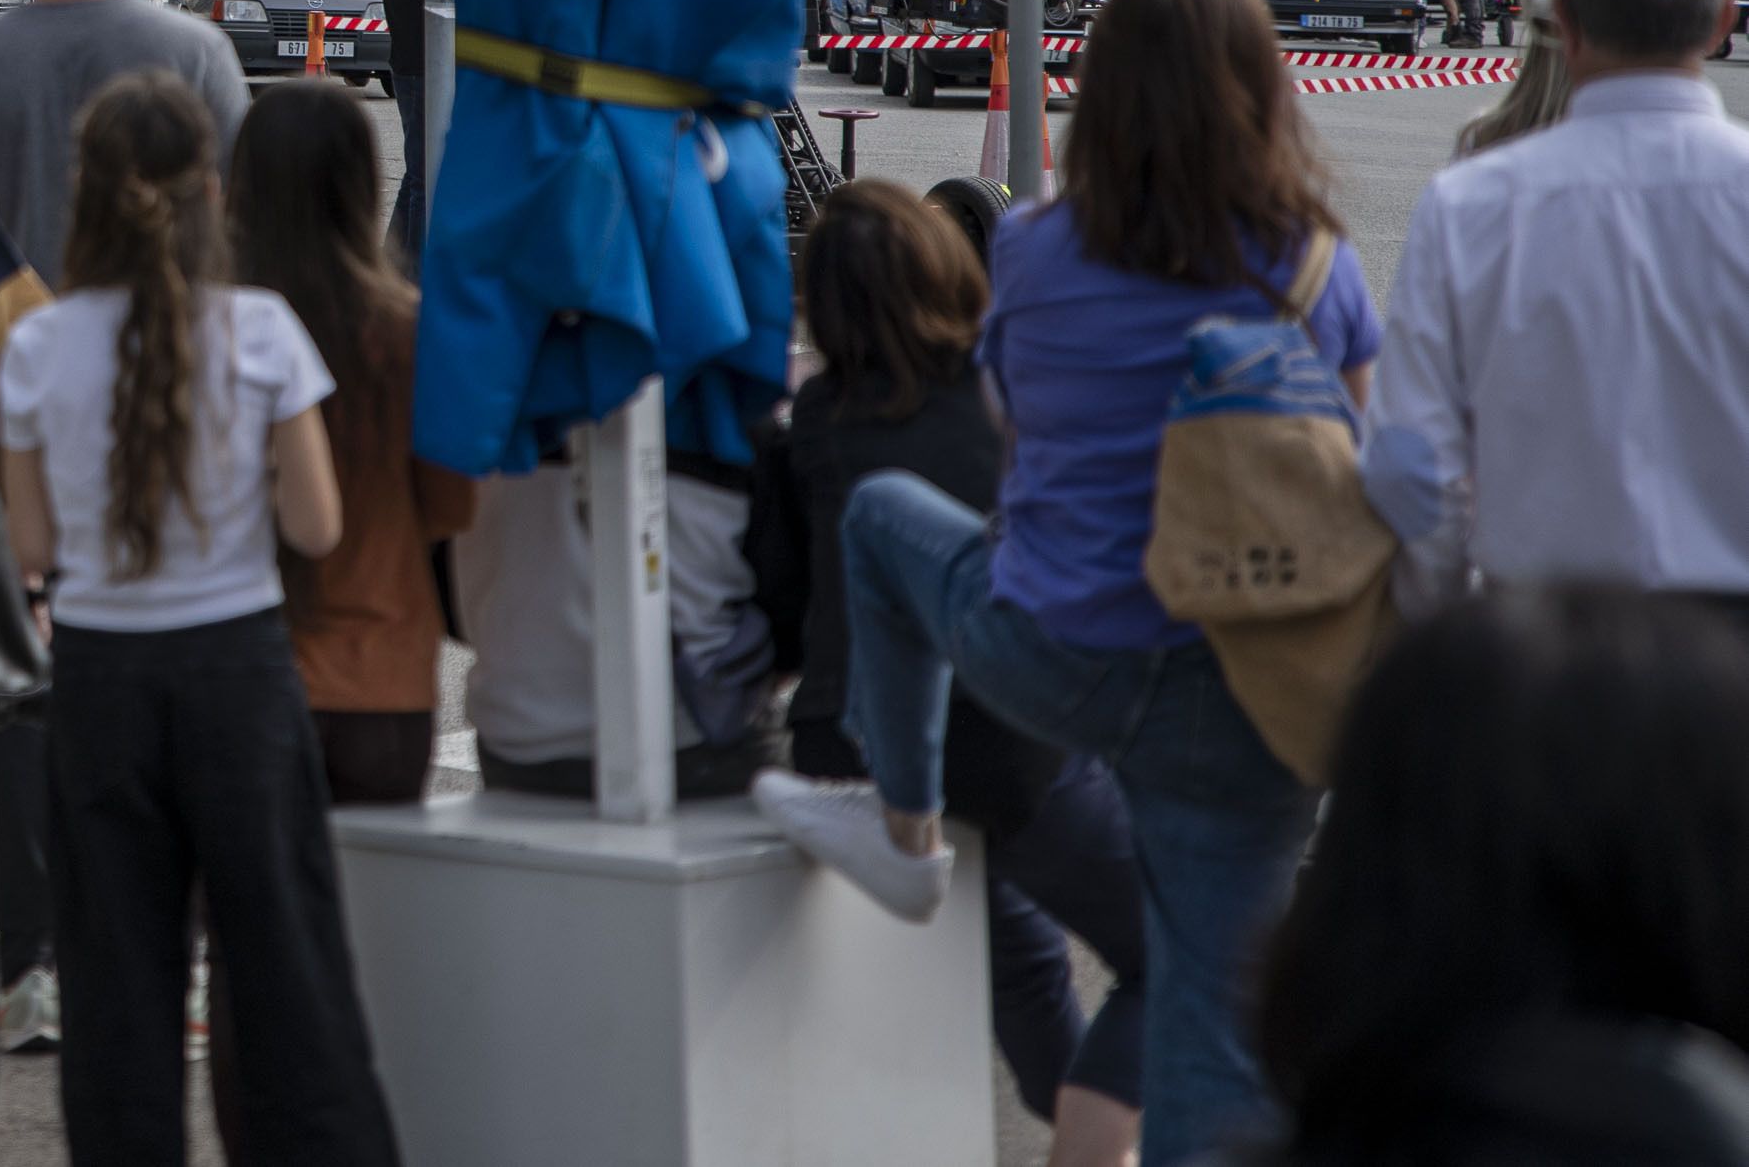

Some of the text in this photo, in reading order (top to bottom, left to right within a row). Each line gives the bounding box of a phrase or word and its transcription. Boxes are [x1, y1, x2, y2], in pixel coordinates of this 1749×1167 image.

[1312, 16, 1328, 27] 214
[1347, 17, 1358, 27] 75
[288, 42, 306, 55] 671
[332, 43, 345, 56] 75
